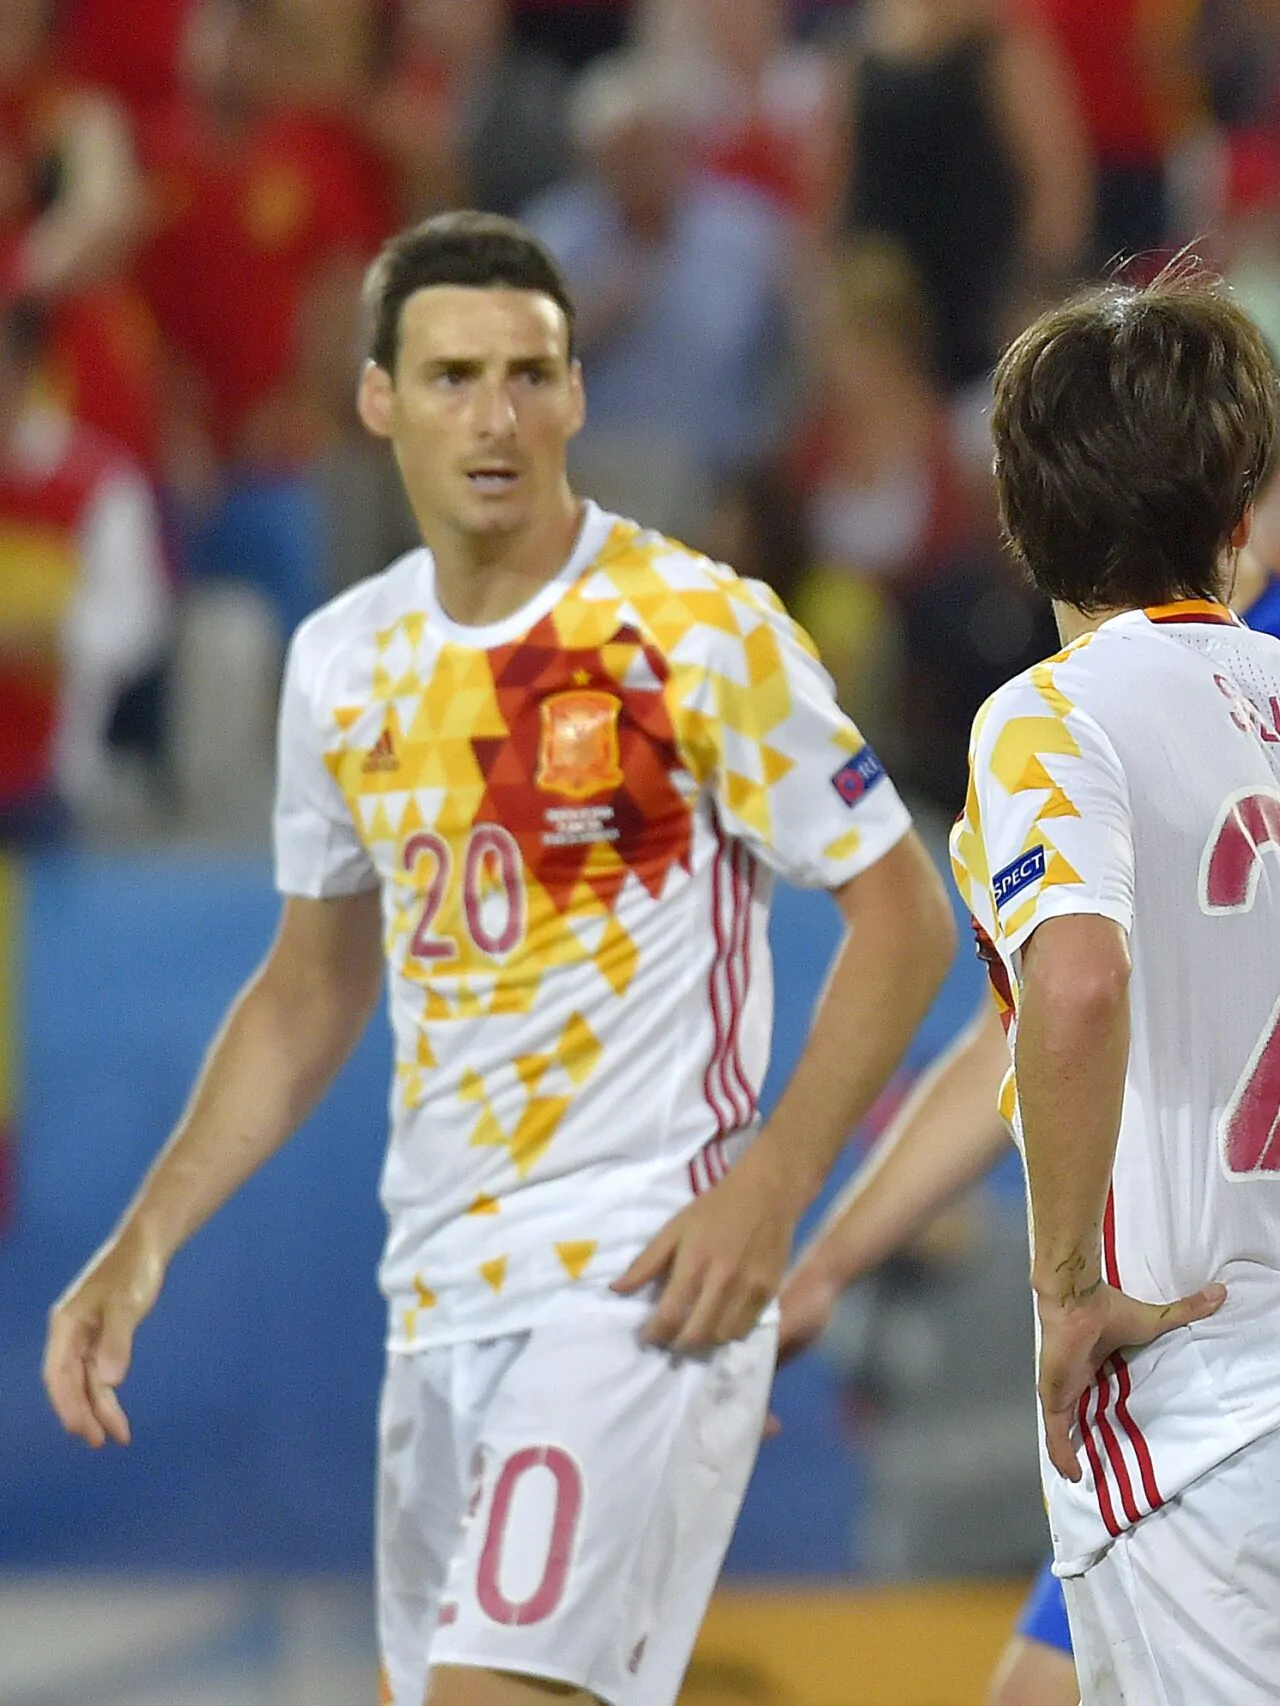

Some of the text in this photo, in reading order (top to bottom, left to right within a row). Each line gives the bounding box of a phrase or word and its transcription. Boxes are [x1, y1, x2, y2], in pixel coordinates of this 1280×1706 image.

[403, 828, 522, 957] 20
[994, 852, 1043, 901] SPECT
[438, 1445, 583, 1627] 0
